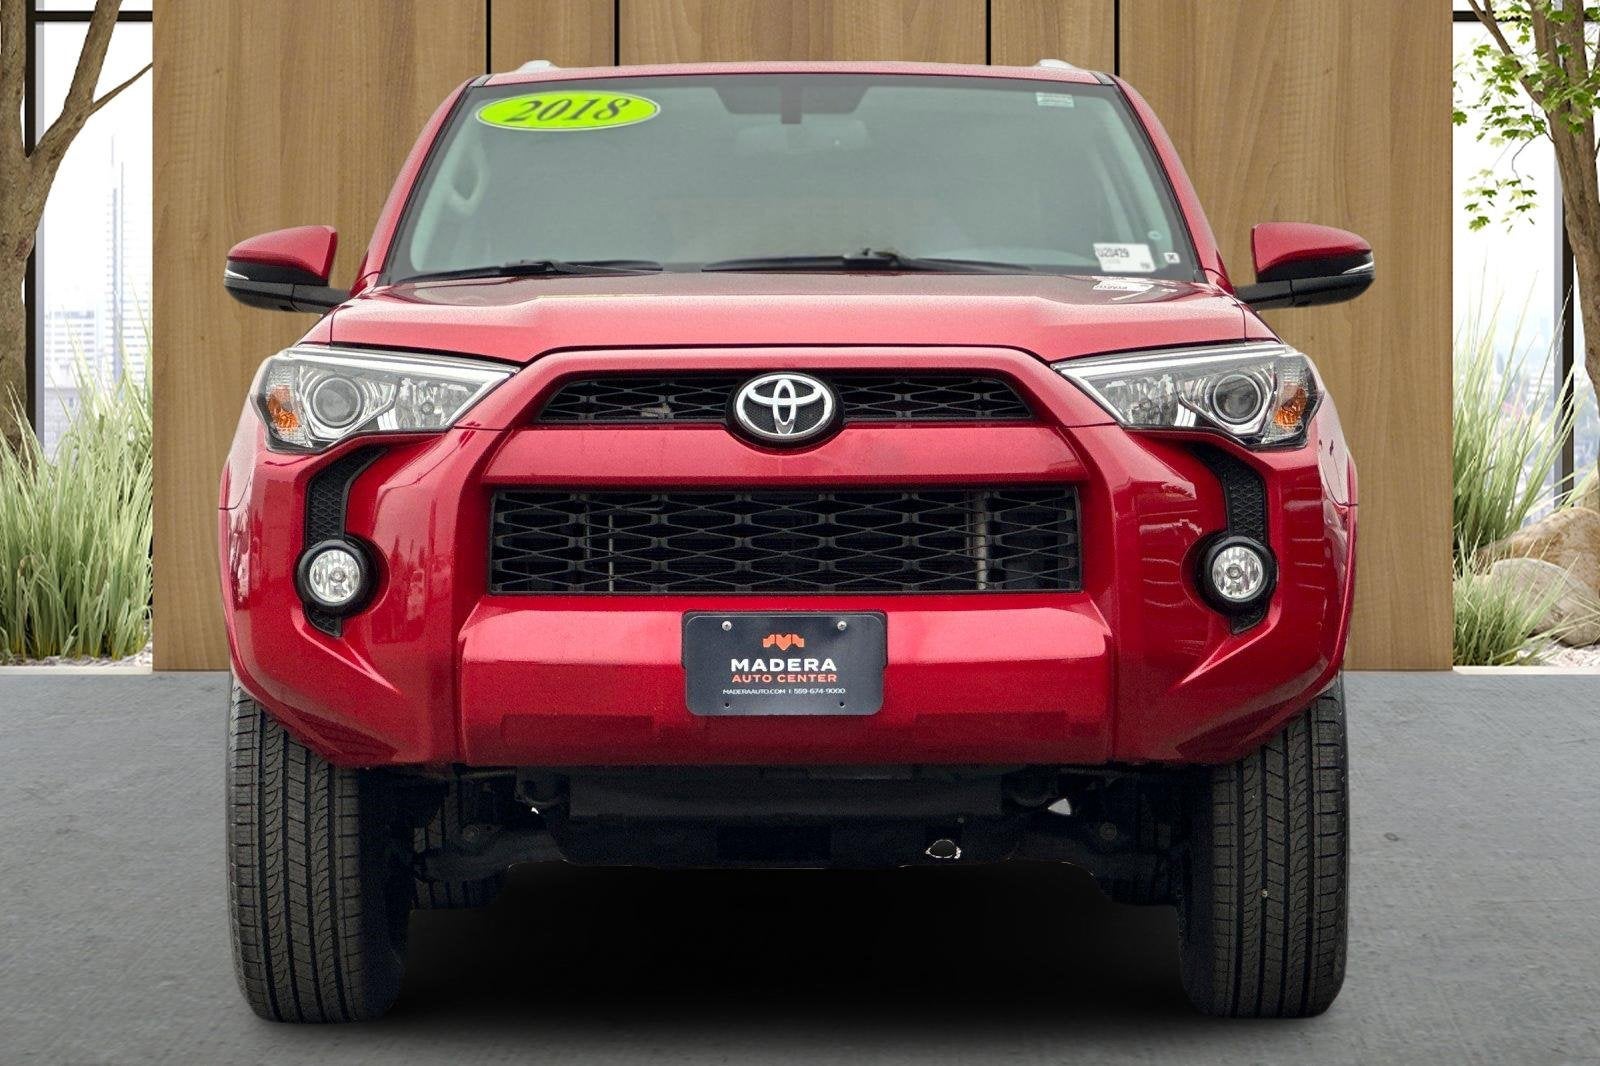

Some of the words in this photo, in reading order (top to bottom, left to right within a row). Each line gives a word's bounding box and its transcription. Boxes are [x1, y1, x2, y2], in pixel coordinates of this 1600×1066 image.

[503, 98, 631, 123] 2018
[730, 658, 837, 672] MADERA
[731, 674, 772, 683] AUTO
[777, 674, 838, 683] CENTER
[793, 687, 846, 695] 559-674-9000
